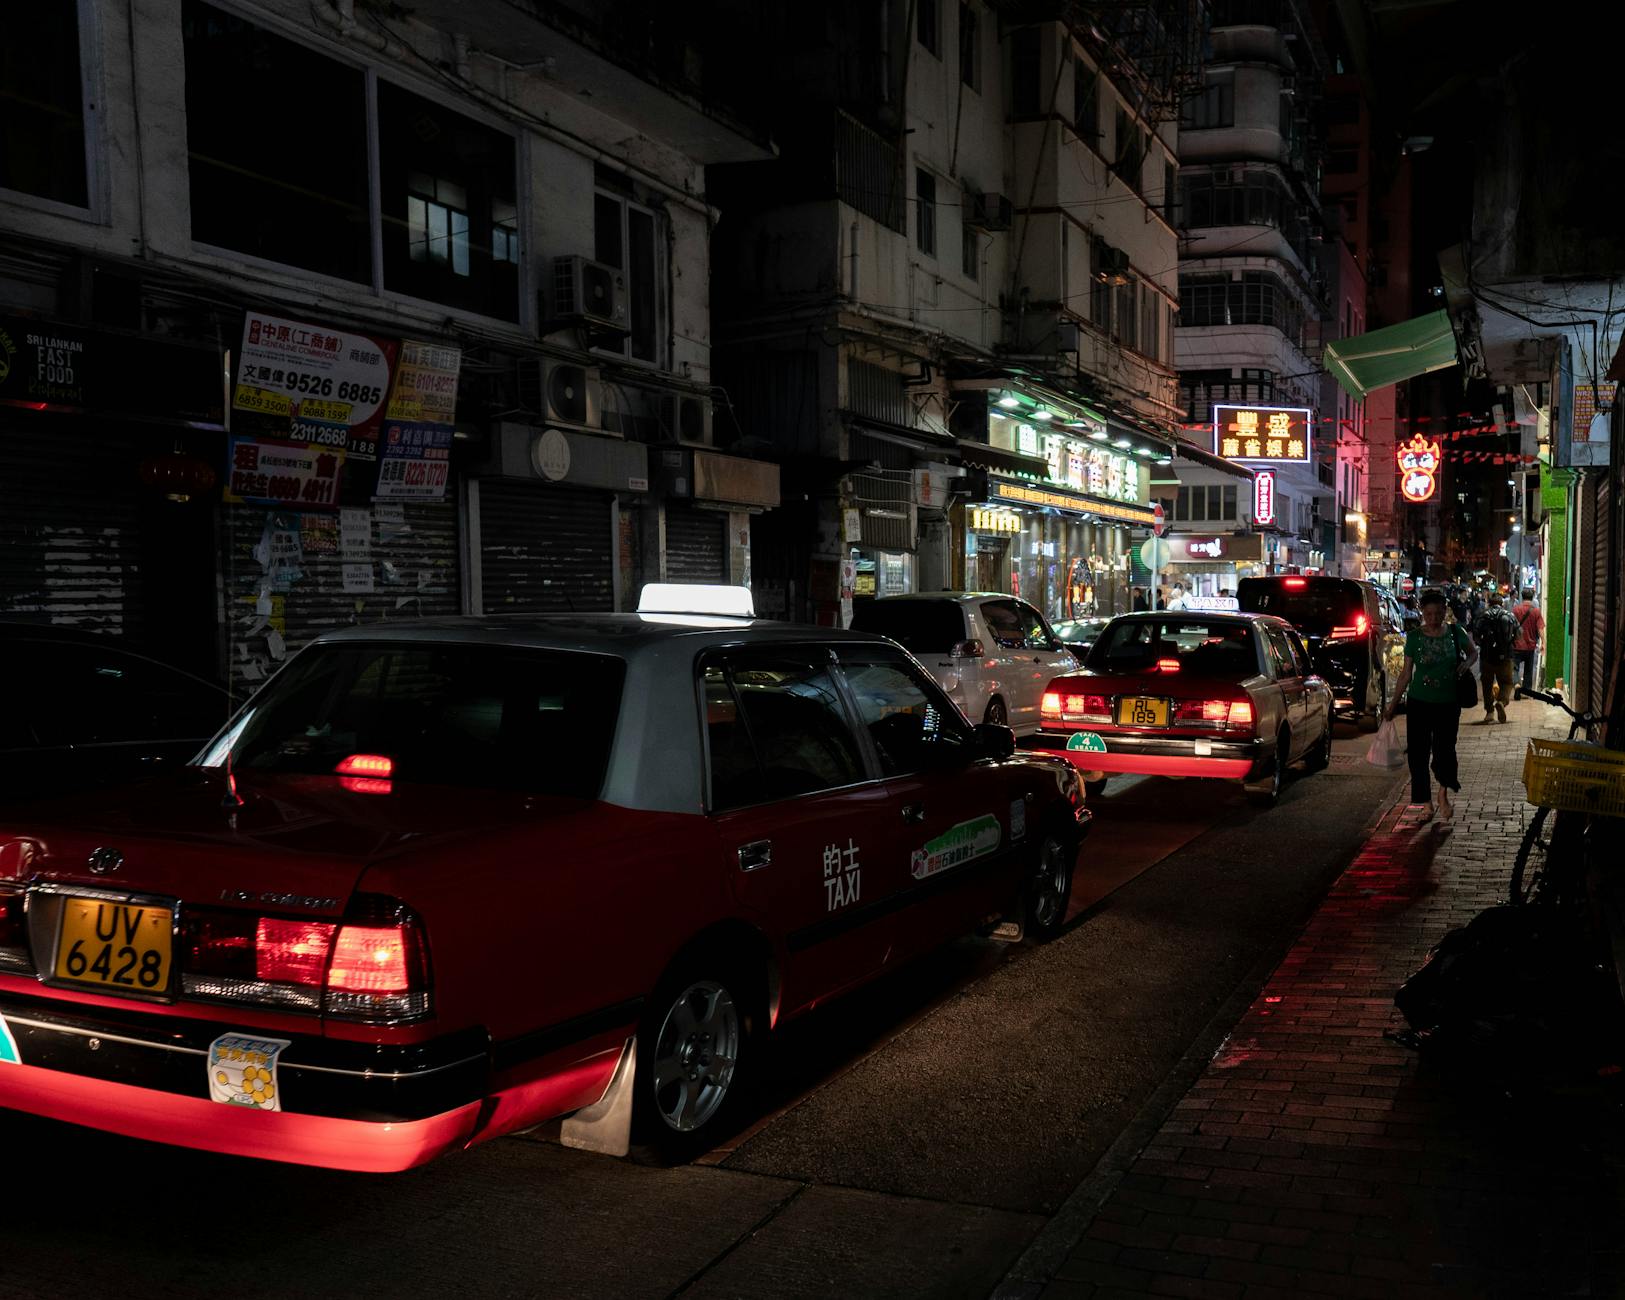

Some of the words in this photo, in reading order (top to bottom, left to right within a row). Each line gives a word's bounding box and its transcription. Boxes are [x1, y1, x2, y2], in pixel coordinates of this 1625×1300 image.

[26, 334, 44, 345] SRI
[45, 337, 83, 352] LANKAN
[37, 346, 72, 367] FAST
[37, 363, 74, 384] FOOD
[286, 371, 333, 396] 9526
[338, 381, 381, 405] 6885
[264, 398, 287, 413] 3500
[290, 423, 315, 441] 2311
[316, 427, 347, 446] 2668
[1134, 700, 1154, 712] RL
[1132, 711, 1156, 723] 189
[1081, 737, 1091, 745] 4
[823, 838, 860, 878] 的士
[823, 869, 861, 912] TAXI
[95, 904, 145, 945] UV
[66, 940, 162, 988] 6428
